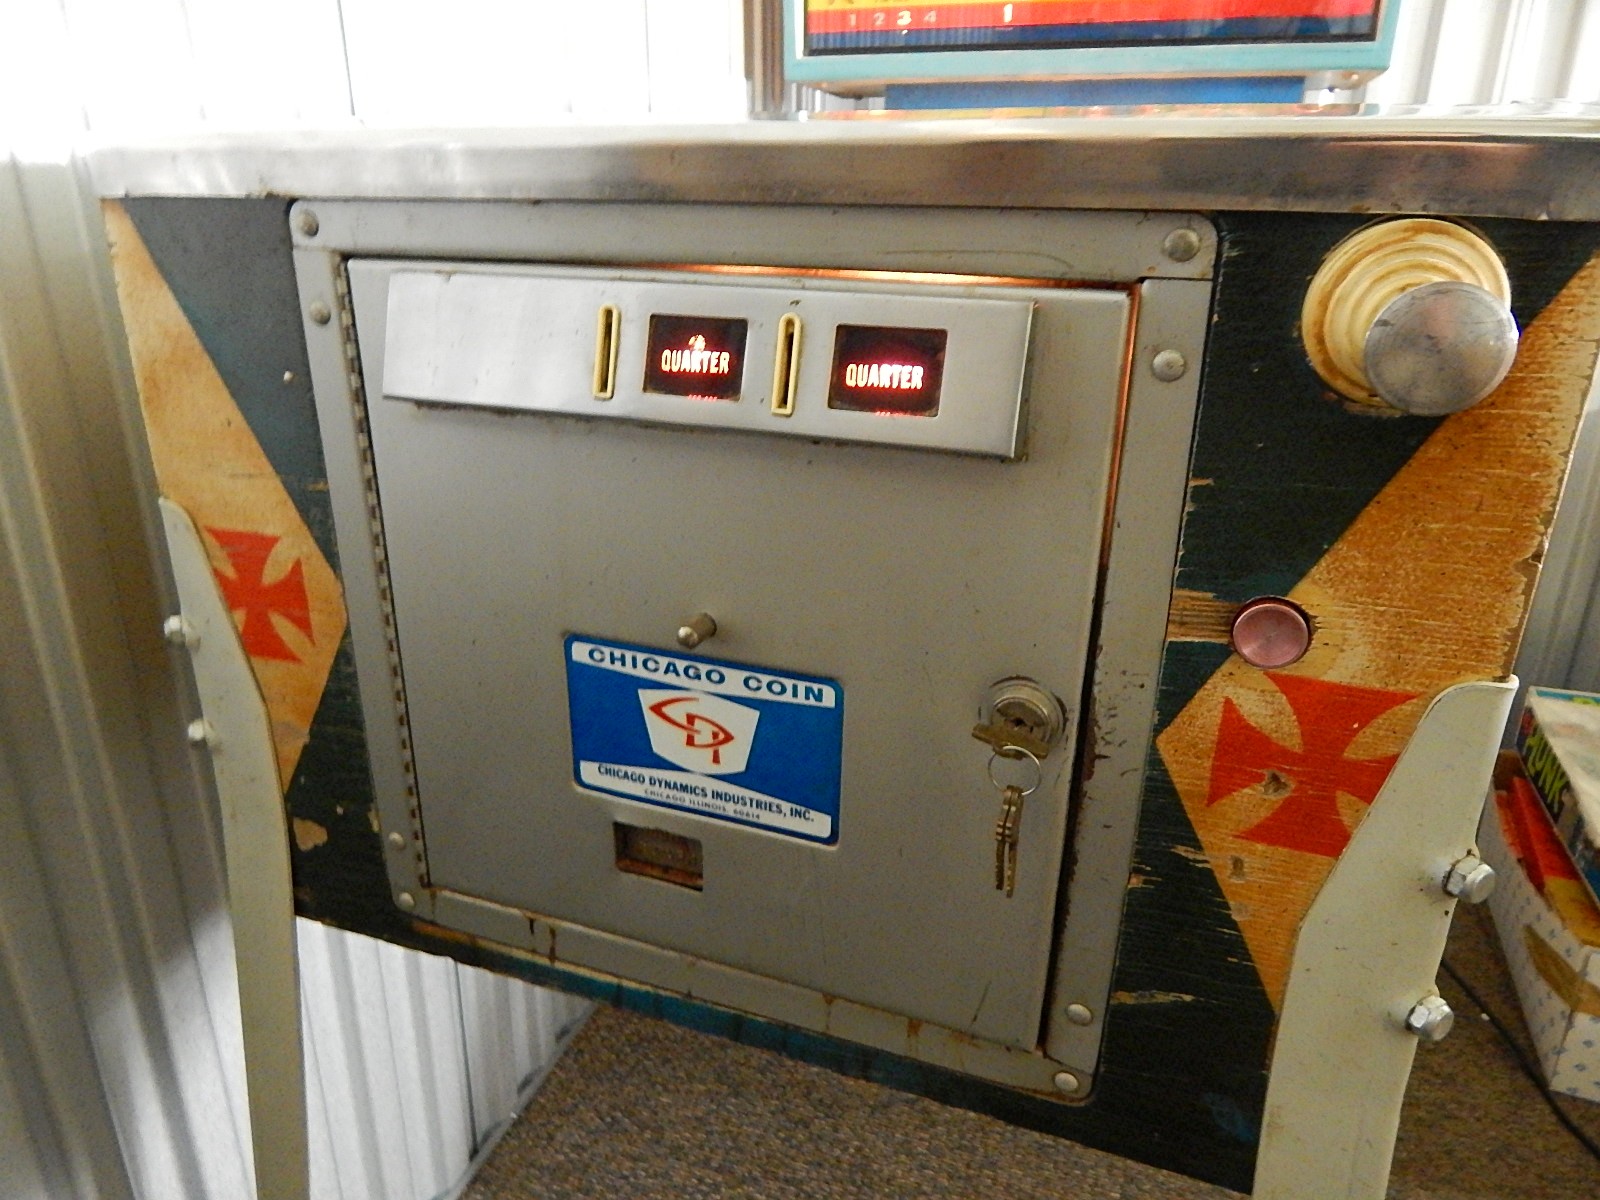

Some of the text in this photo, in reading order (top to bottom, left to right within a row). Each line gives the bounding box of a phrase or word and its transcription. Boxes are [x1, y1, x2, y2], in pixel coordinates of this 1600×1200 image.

[874, 13, 885, 26] 2
[897, 10, 912, 26] 3
[924, 11, 937, 23] 4
[661, 349, 730, 375] QUARTER
[845, 363, 924, 390] QUARTER
[588, 647, 825, 703] CHICAGO COIN
[597, 763, 815, 823] CHICAGO DYNAMICS INDUSTRIES, INC.
[644, 788, 686, 804] CHICAGO
